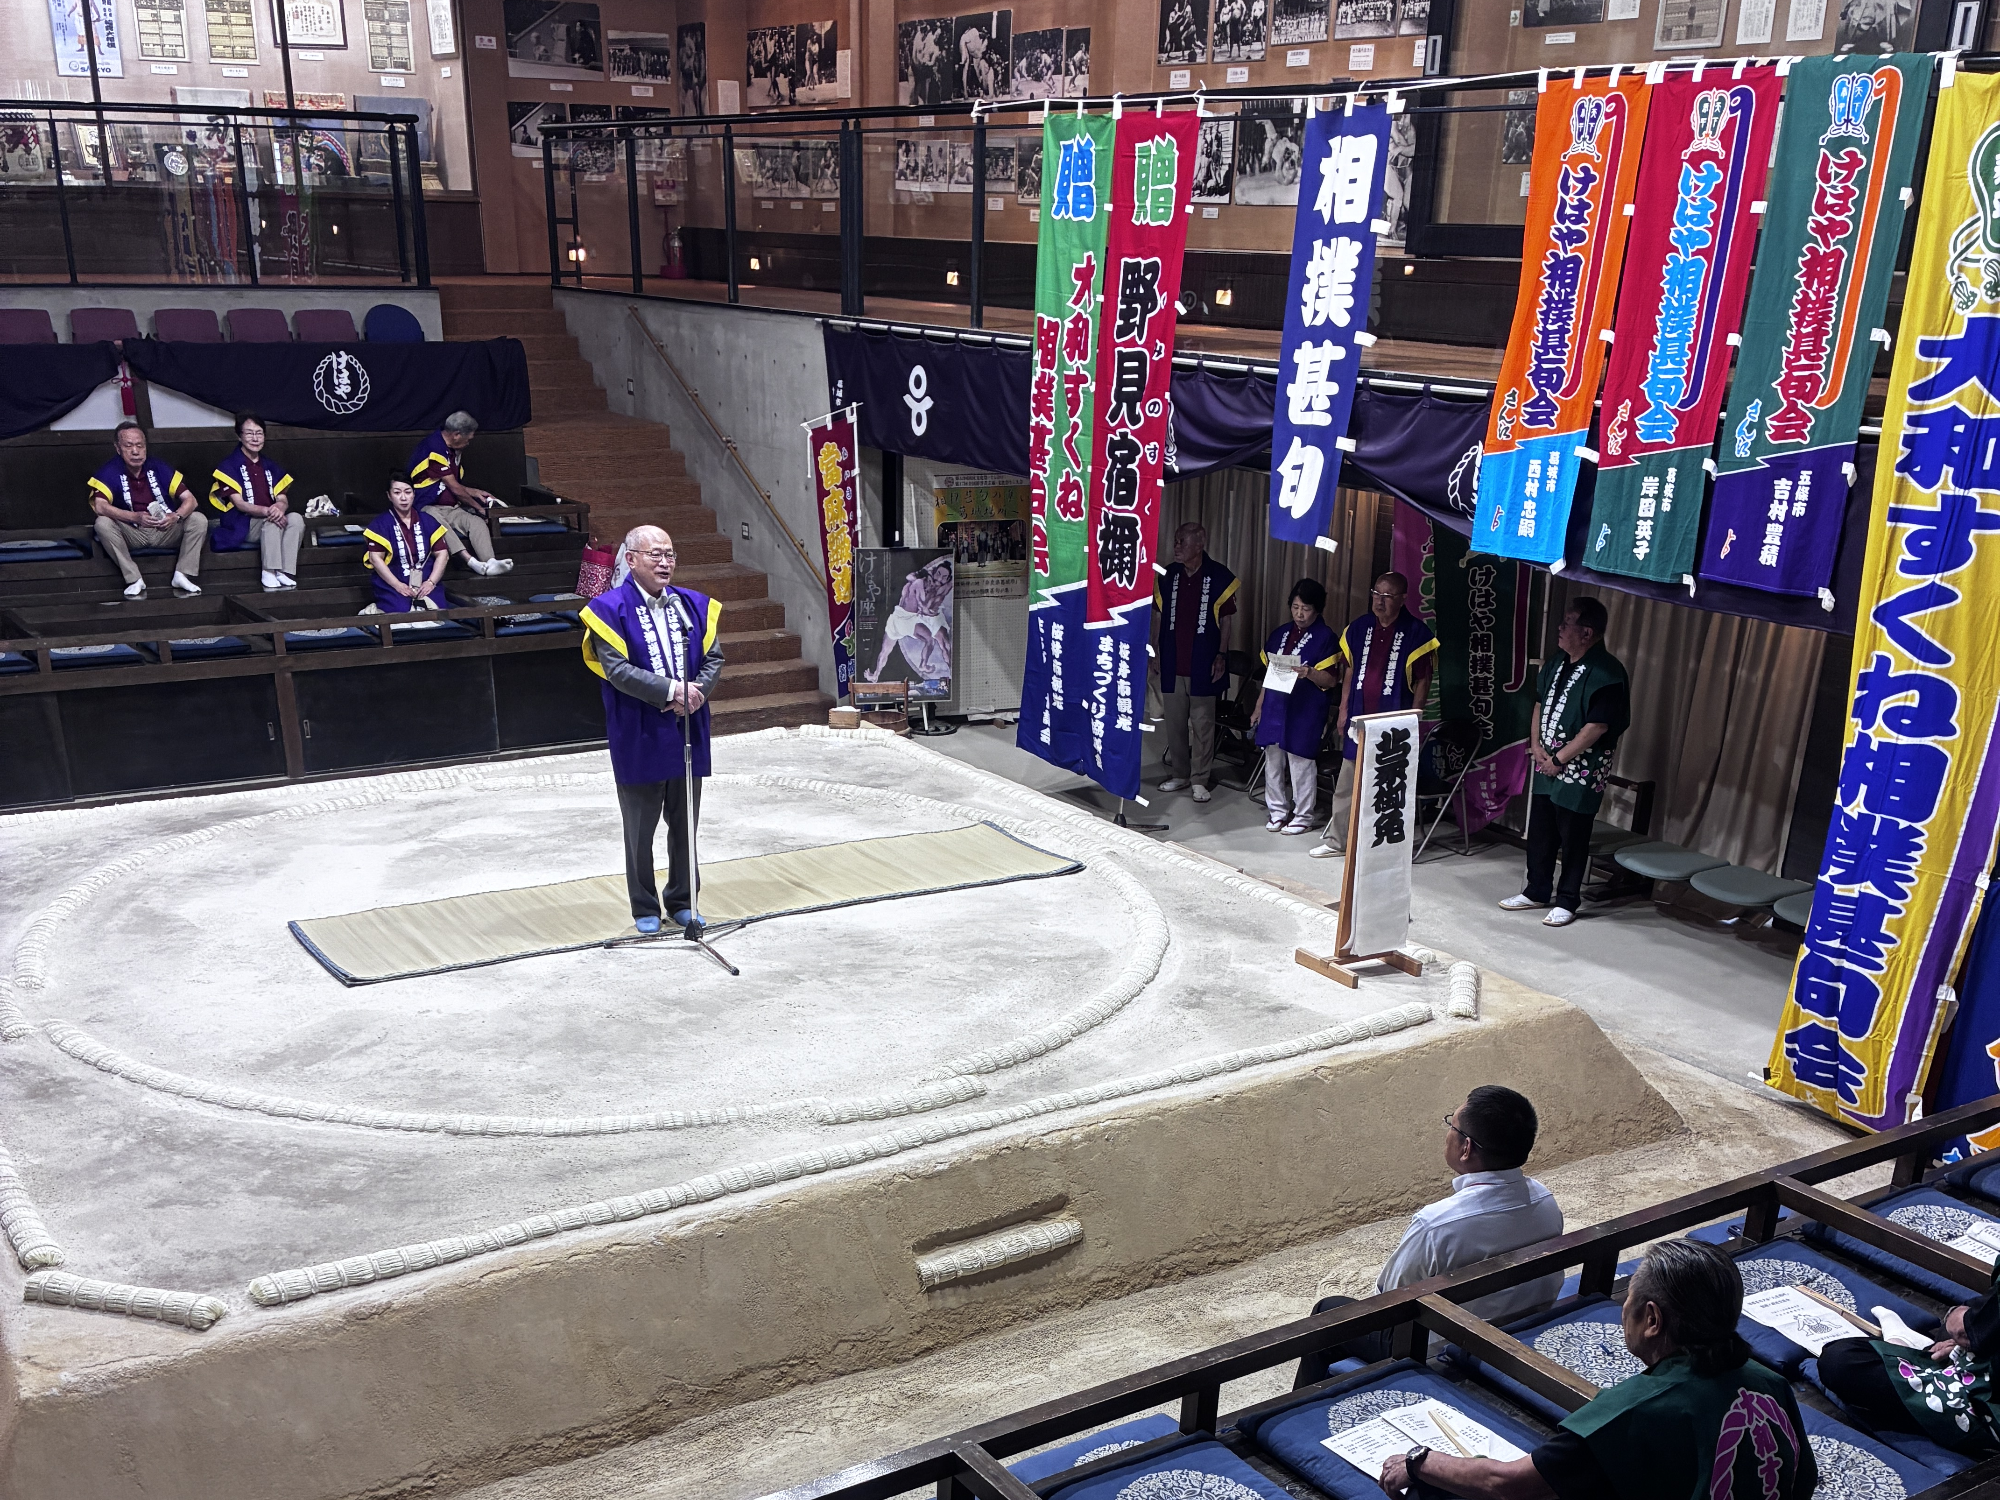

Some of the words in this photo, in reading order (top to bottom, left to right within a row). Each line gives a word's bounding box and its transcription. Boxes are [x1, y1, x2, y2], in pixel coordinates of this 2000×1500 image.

[1051, 132, 1096, 223] 贈
[1131, 132, 1179, 227] 贈
[331, 350, 352, 400] けはや
[1277, 133, 1378, 521] 相撲甚句
[1519, 162, 1600, 431] けはや相撲甚句会
[1635, 159, 1724, 445] けはや相撲甚句会
[1765, 146, 1866, 445] けはや相撲甚句会
[1737, 1386, 1783, 1500] 大和す
